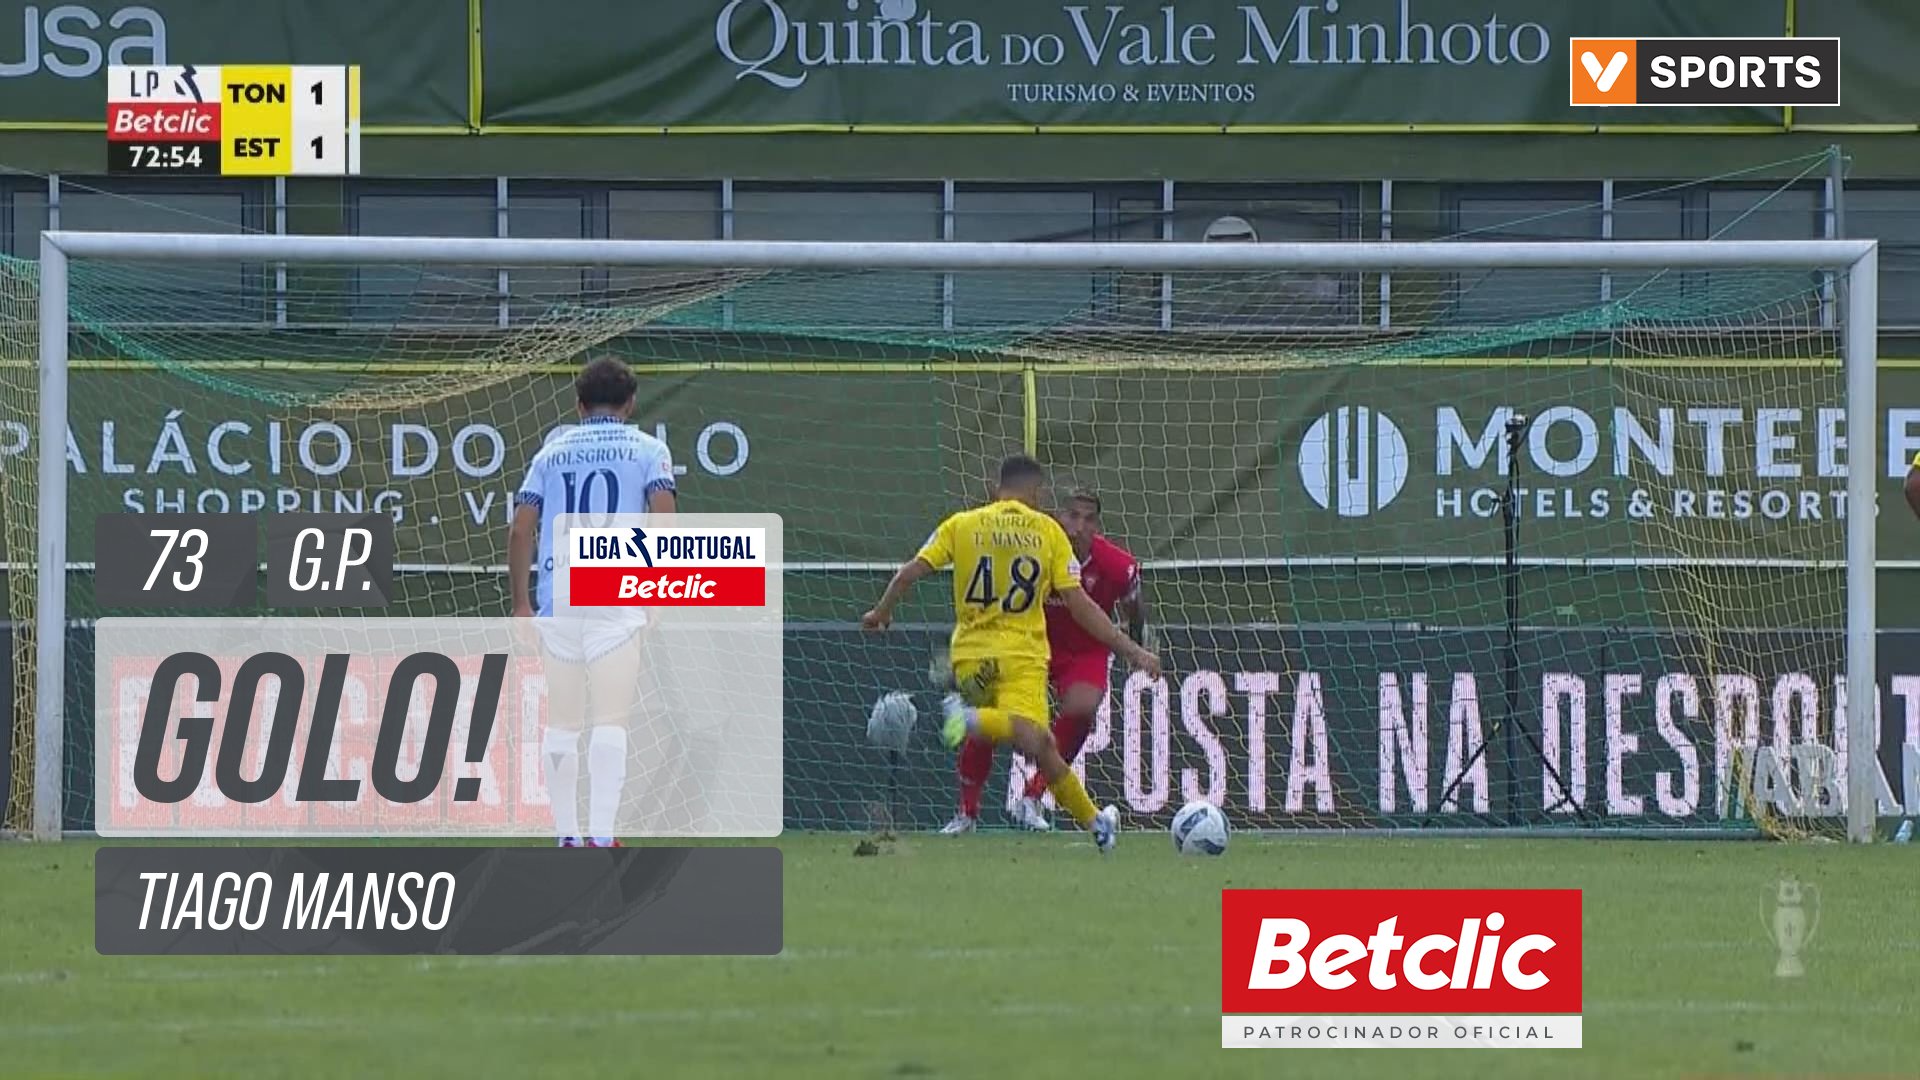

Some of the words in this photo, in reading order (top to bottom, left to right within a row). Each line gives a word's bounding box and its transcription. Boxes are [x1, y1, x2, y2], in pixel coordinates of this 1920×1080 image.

[715, 0, 990, 88] Quinta
[1000, 34, 1064, 66] DO
[1063, 5, 1215, 66] Vale
[1237, 0, 1550, 64] Minhoto
[1007, 84, 1116, 102] TURISMO
[1122, 84, 1140, 102] &
[1148, 84, 1255, 102] EVENTOS
[391, 422, 506, 477] DO
[546, 447, 639, 468] HOLSGROVE
[561, 467, 621, 534] 10
[1436, 488, 1610, 518] HOTELS
[1627, 488, 1654, 518] &
[1674, 489, 1880, 519] RESORT
[992, 531, 1042, 549] MANSO
[964, 555, 1040, 614] 48
[1378, 671, 1491, 815] NA
